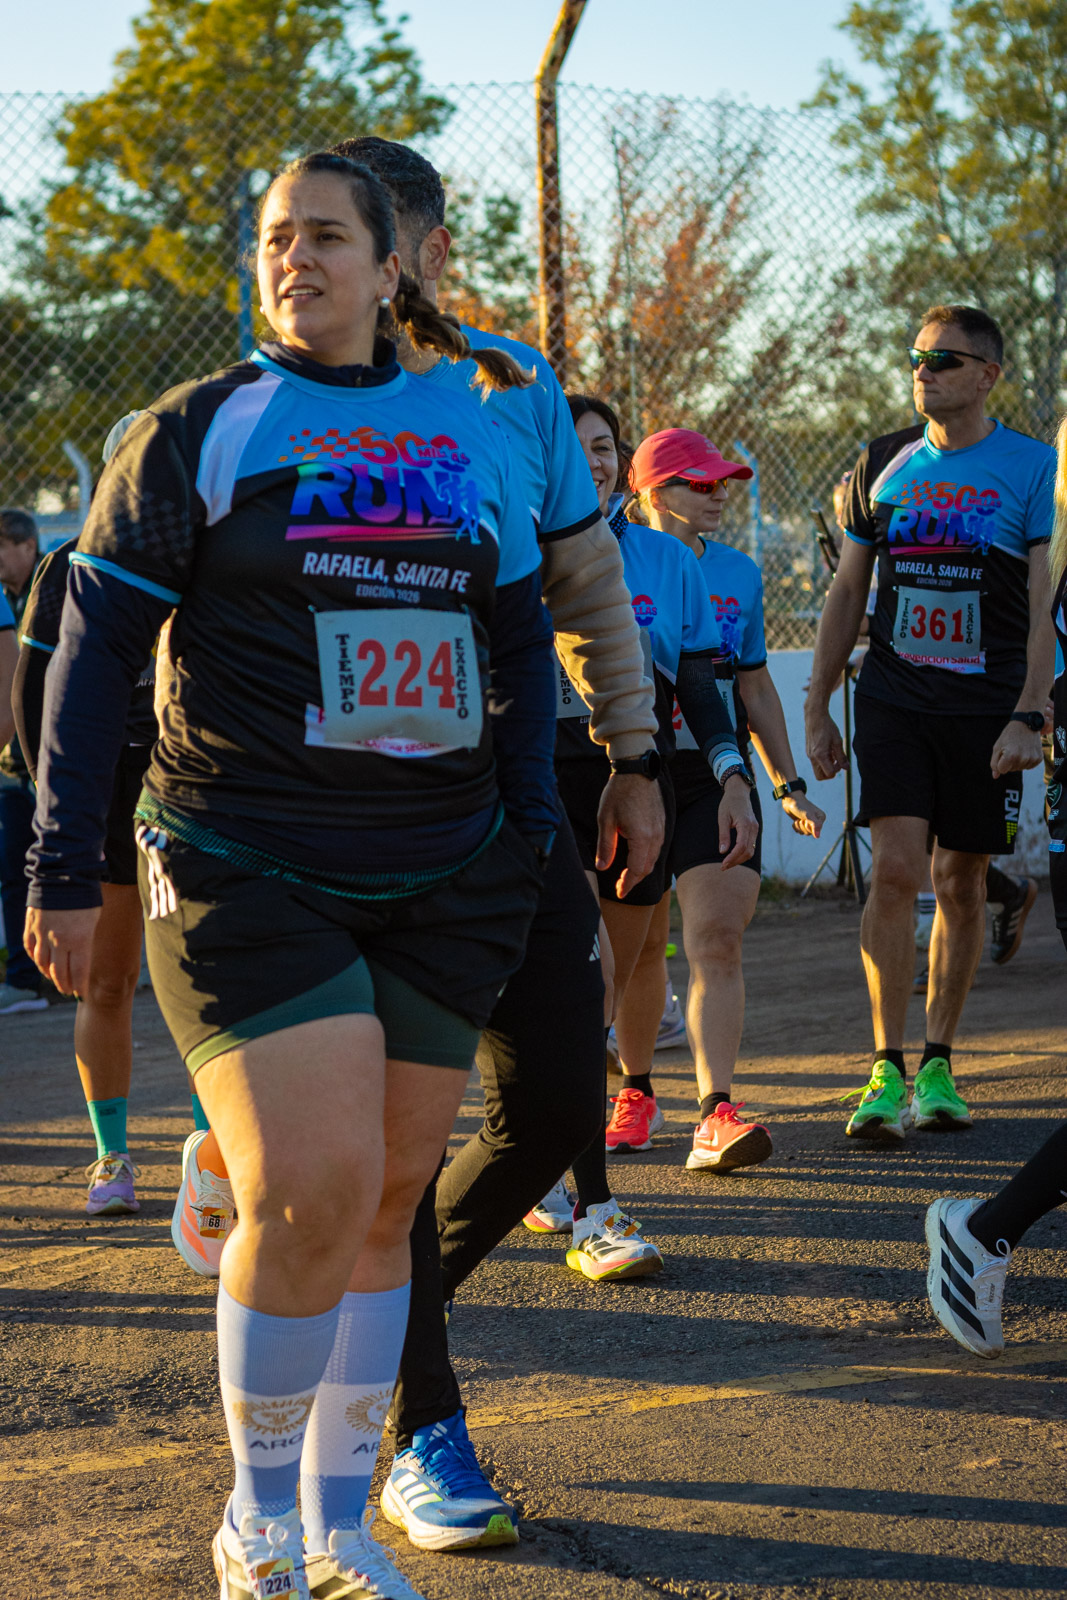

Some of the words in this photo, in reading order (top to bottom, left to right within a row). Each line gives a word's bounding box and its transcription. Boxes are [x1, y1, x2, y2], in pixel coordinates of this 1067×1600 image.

[290, 462, 461, 526] RUN
[887, 506, 978, 546] RUN
[302, 551, 389, 583] RAFAELA,
[393, 561, 446, 590] SANTA
[449, 570, 471, 593] FE
[895, 560, 936, 576] RAFAELA,
[938, 564, 969, 580] SANTA
[971, 567, 983, 580] FE
[900, 597, 911, 639] TIEMPO
[910, 604, 964, 643] 361
[965, 603, 974, 645] EXACTO
[335, 633, 355, 714] TIEMPO
[357, 638, 456, 709] 224
[454, 637, 469, 719] EXACTO
[208, 1218, 220, 1228] 68
[266, 1574, 292, 1595] 224
